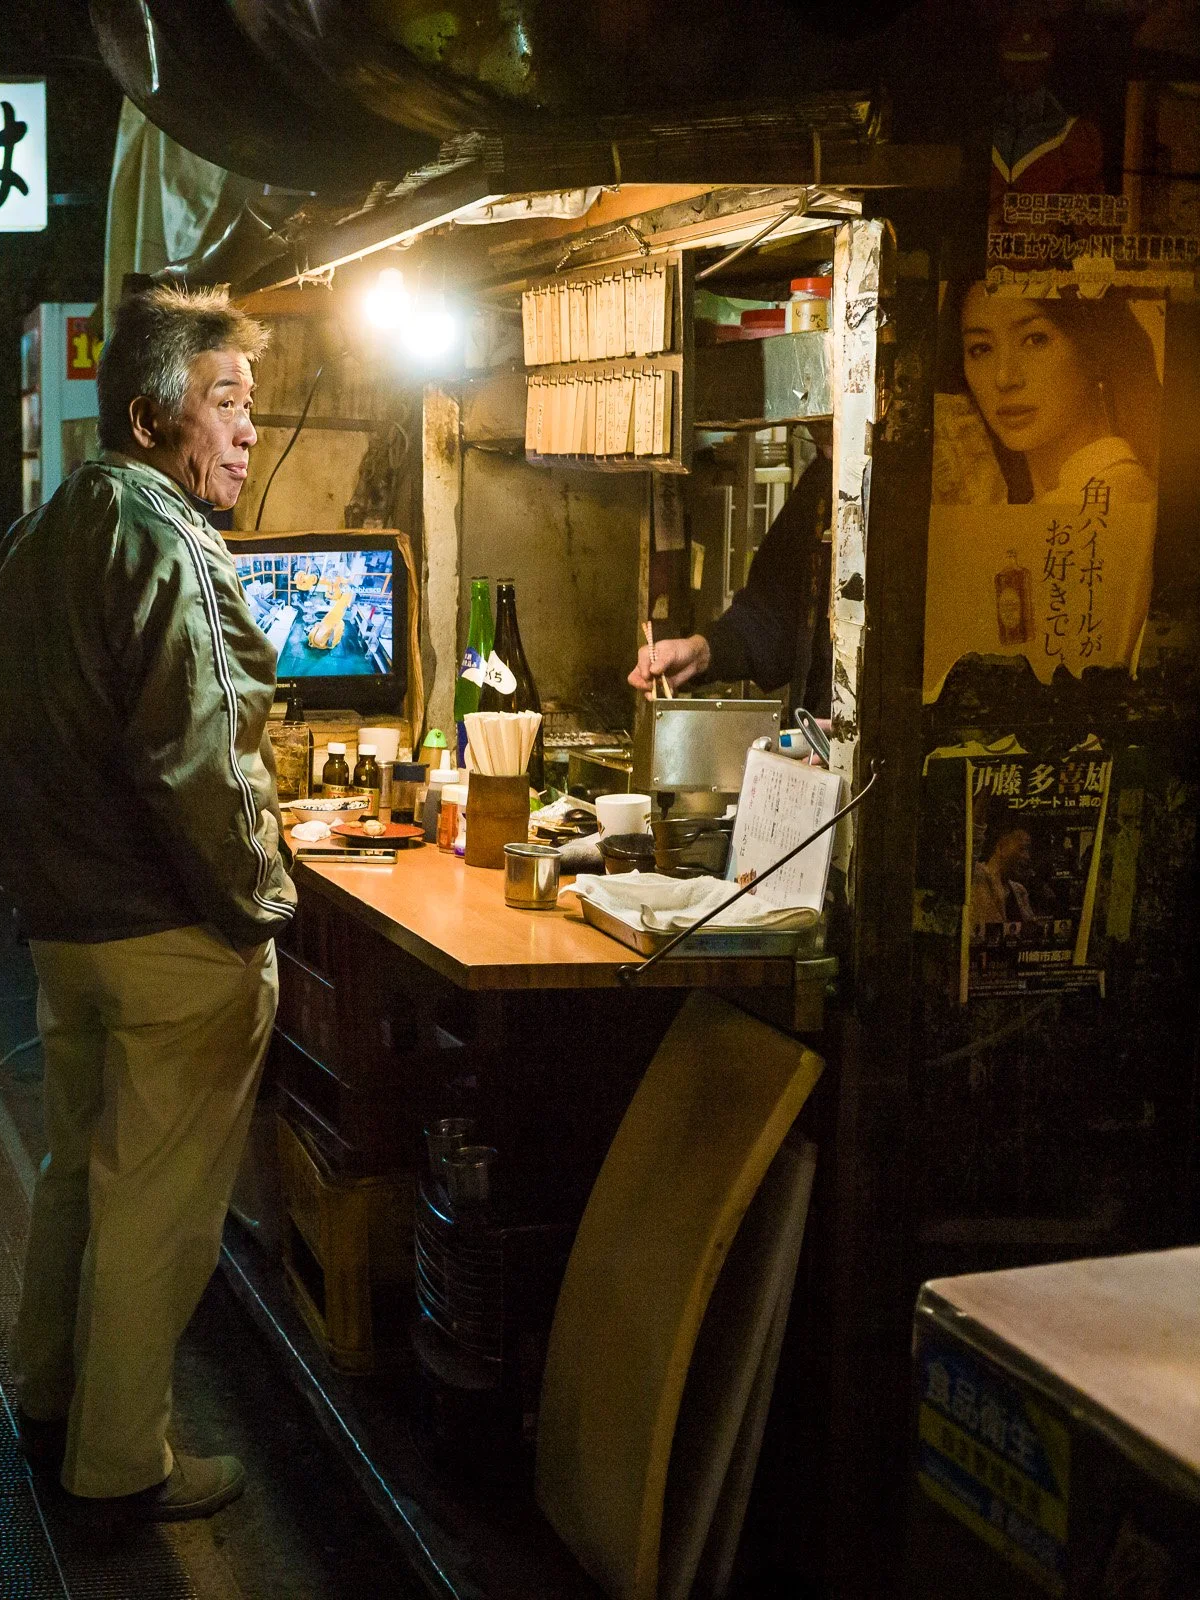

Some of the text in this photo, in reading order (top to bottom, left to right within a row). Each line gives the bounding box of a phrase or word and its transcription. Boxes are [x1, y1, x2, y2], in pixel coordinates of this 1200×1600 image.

[1078, 476, 1111, 658] 角ハイボールが
